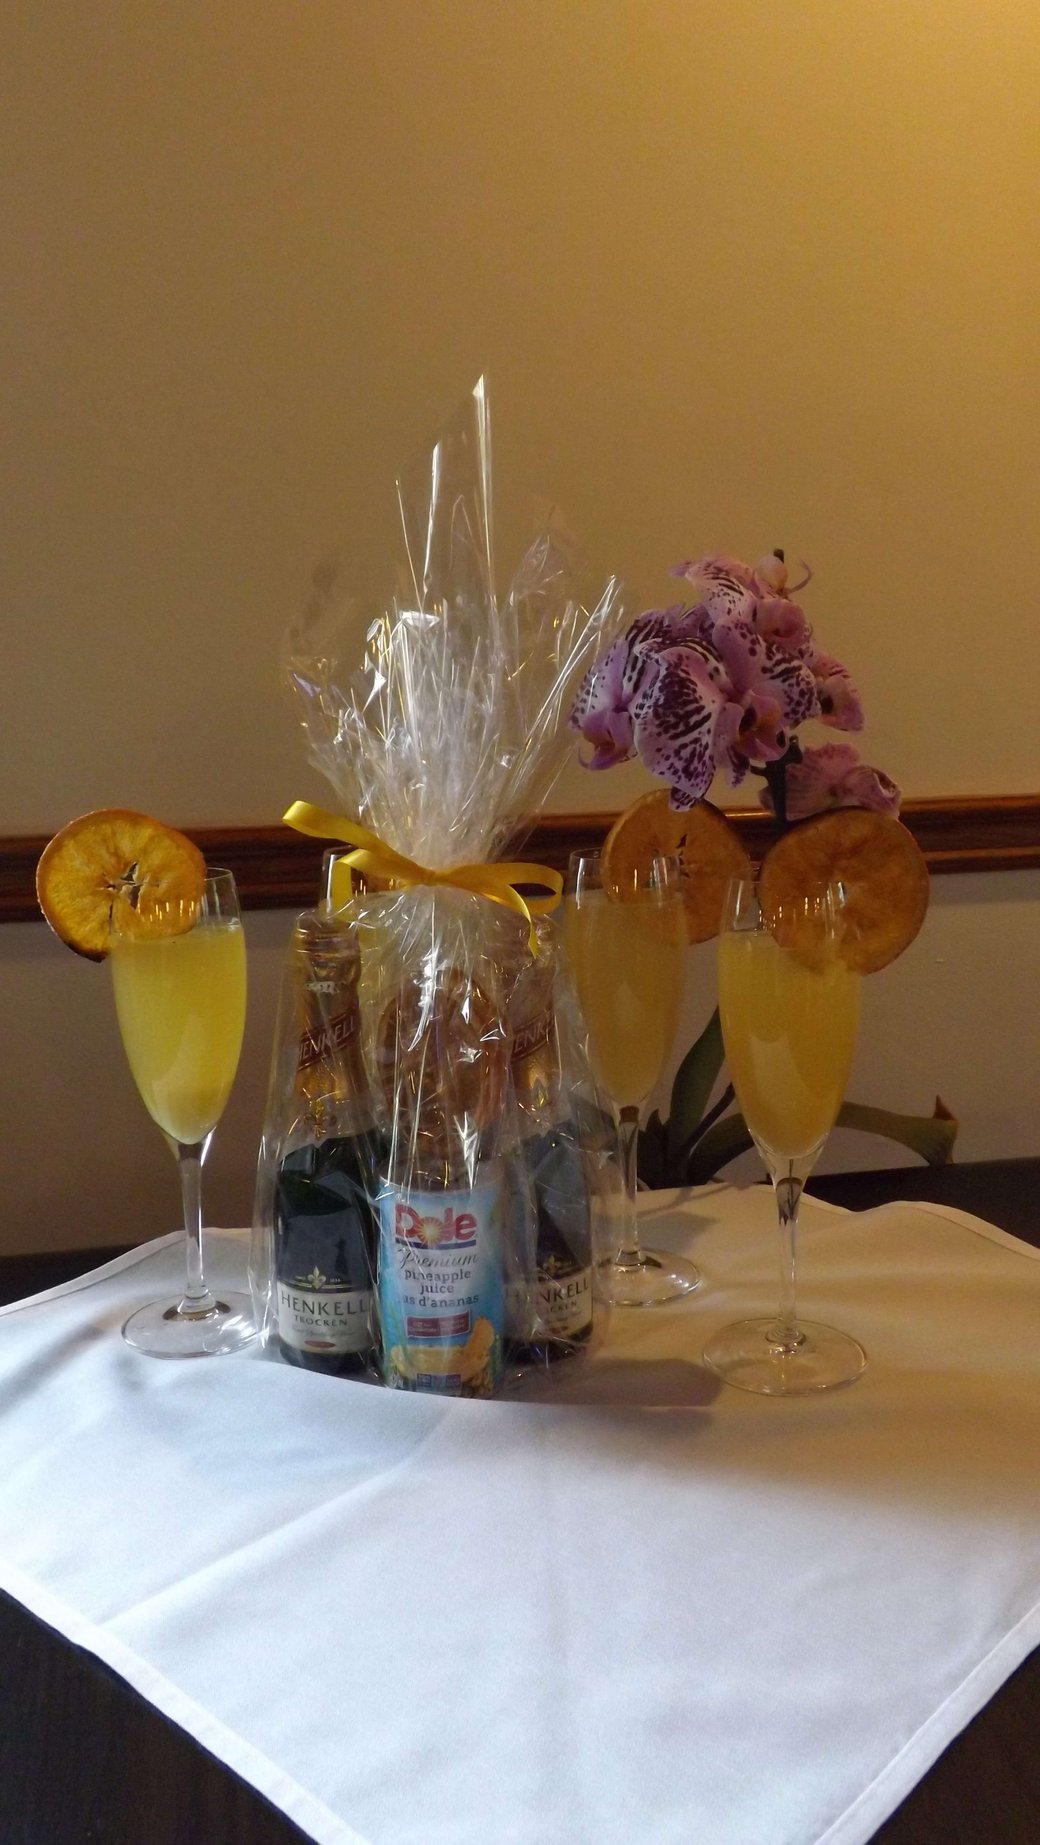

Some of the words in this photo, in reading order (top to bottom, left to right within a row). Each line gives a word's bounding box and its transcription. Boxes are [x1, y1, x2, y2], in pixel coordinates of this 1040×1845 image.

[395, 1203, 478, 1244] Dole
[398, 1248, 479, 1270] Premium
[404, 1268, 471, 1284] pineapple
[420, 1282, 455, 1296] juice
[281, 1289, 368, 1316] HENKELL
[295, 1314, 348, 1327] TROCKEN
